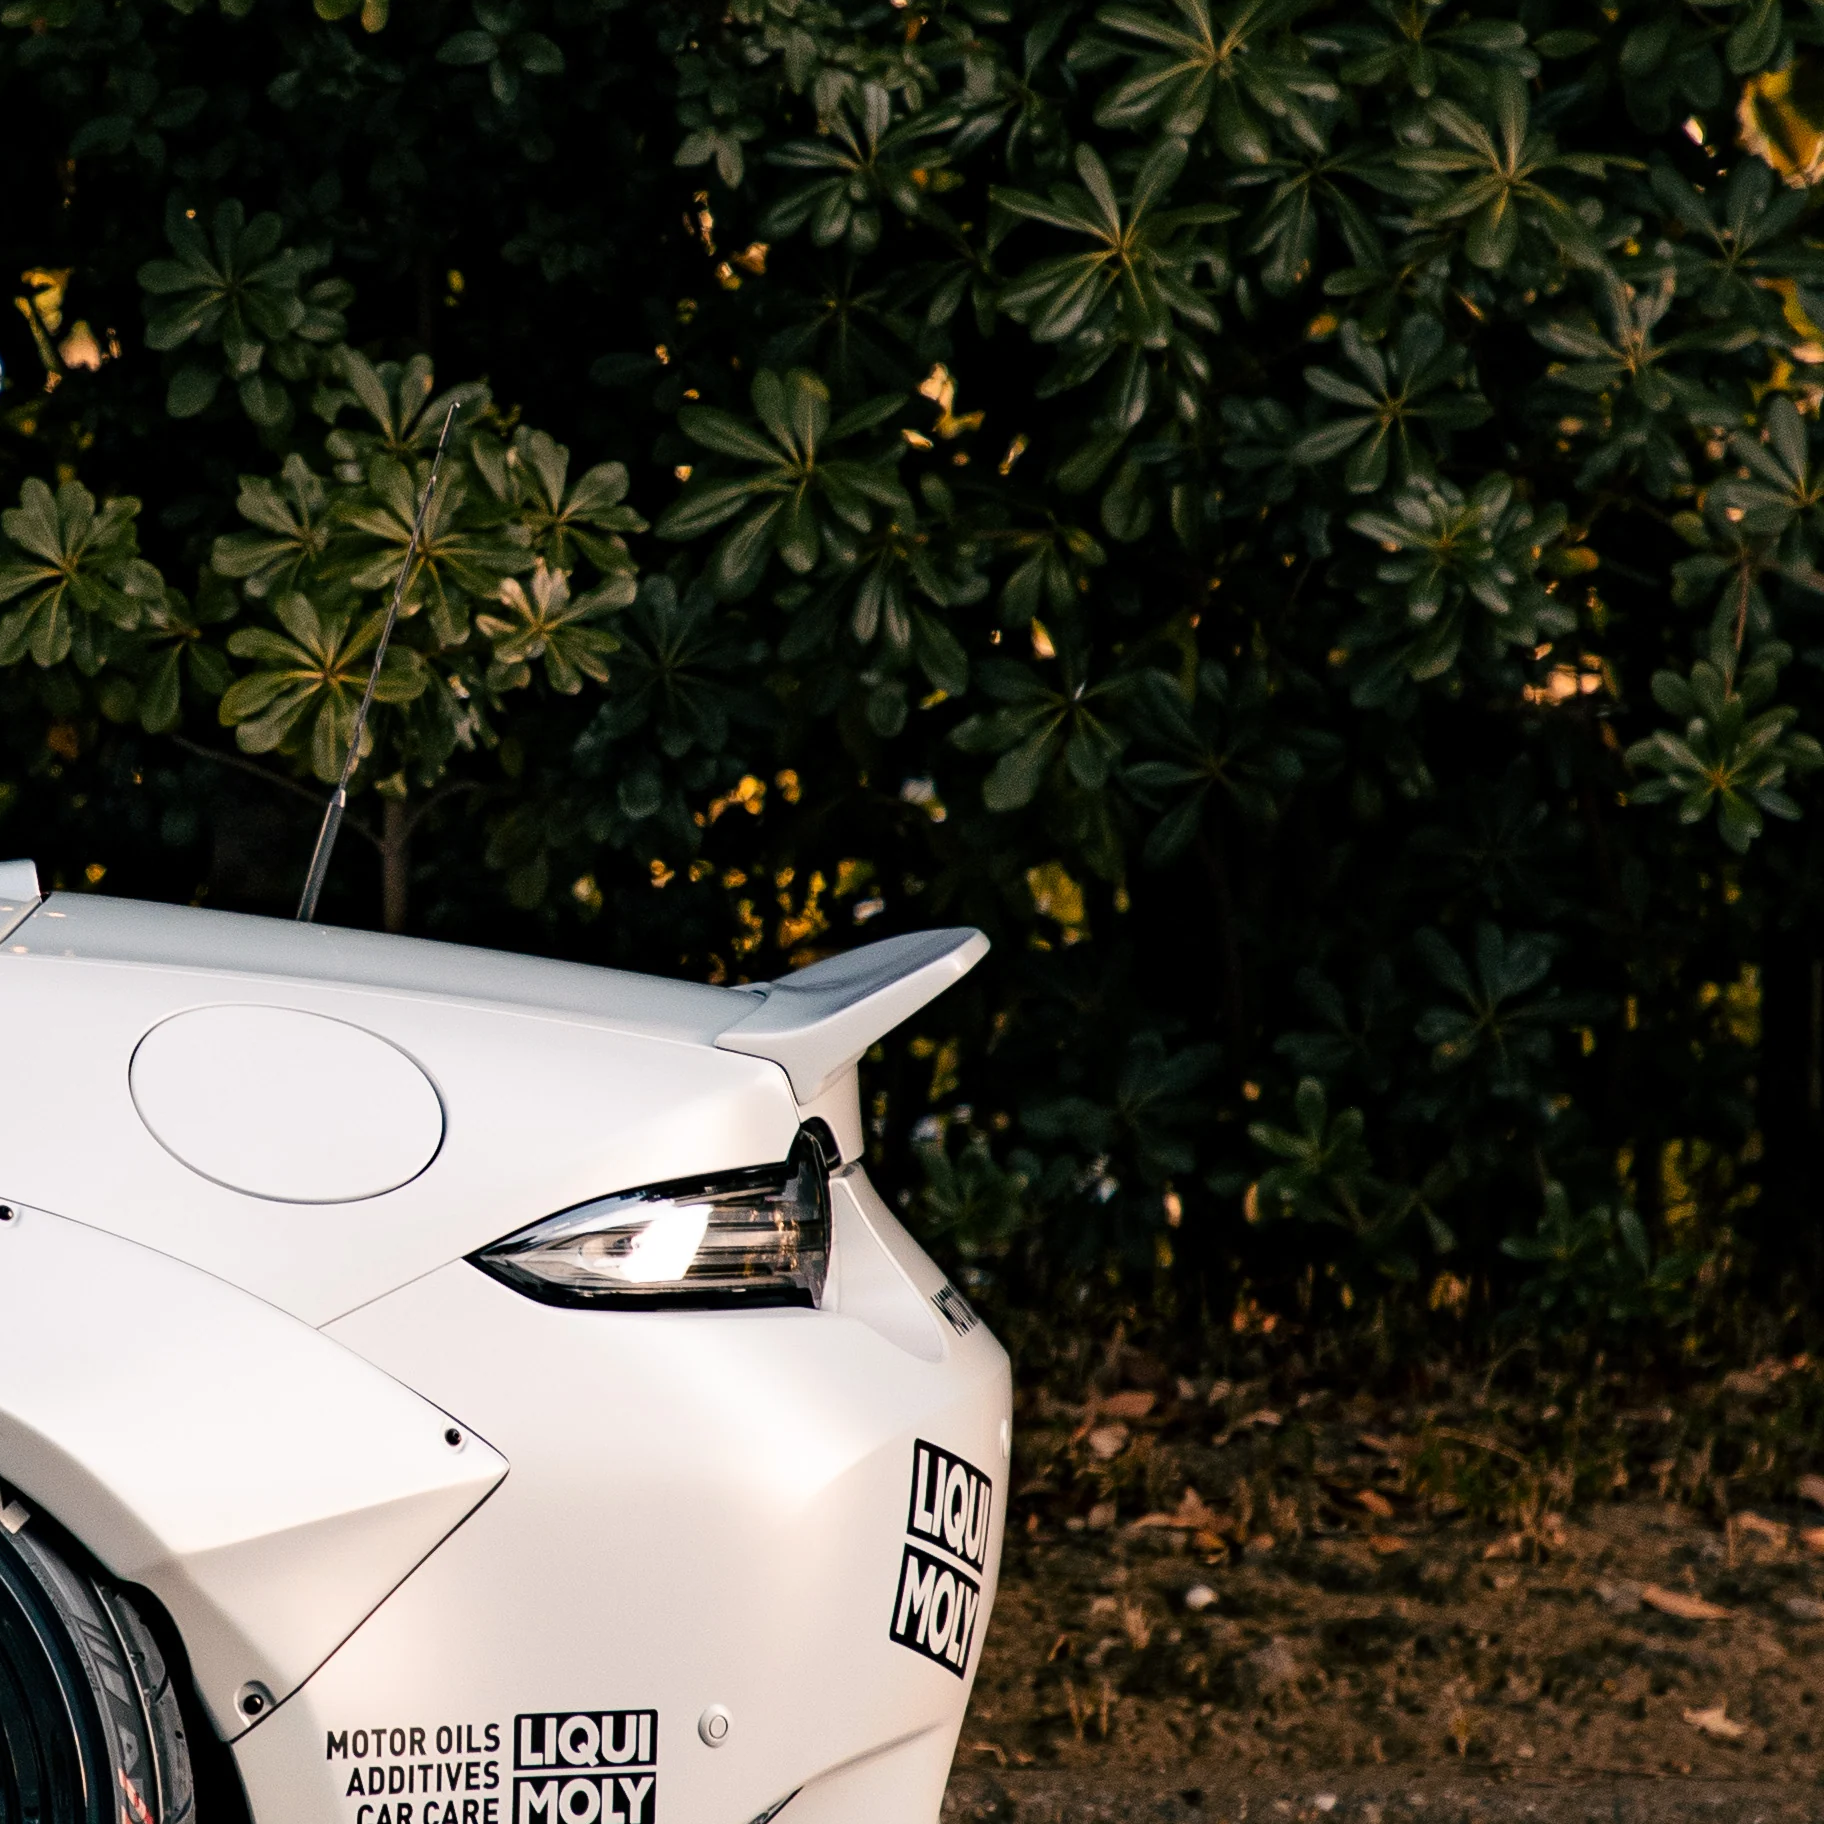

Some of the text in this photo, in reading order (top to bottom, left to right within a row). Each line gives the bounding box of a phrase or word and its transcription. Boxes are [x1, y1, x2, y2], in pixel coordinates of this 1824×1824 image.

[913, 1448, 992, 1566] LIQUI
[895, 1554, 980, 1670] MOLY
[326, 1723, 500, 1760] MOTOR OILS
[520, 1714, 651, 1767] LIQUI
[345, 1761, 500, 1797] ADDITIVES
